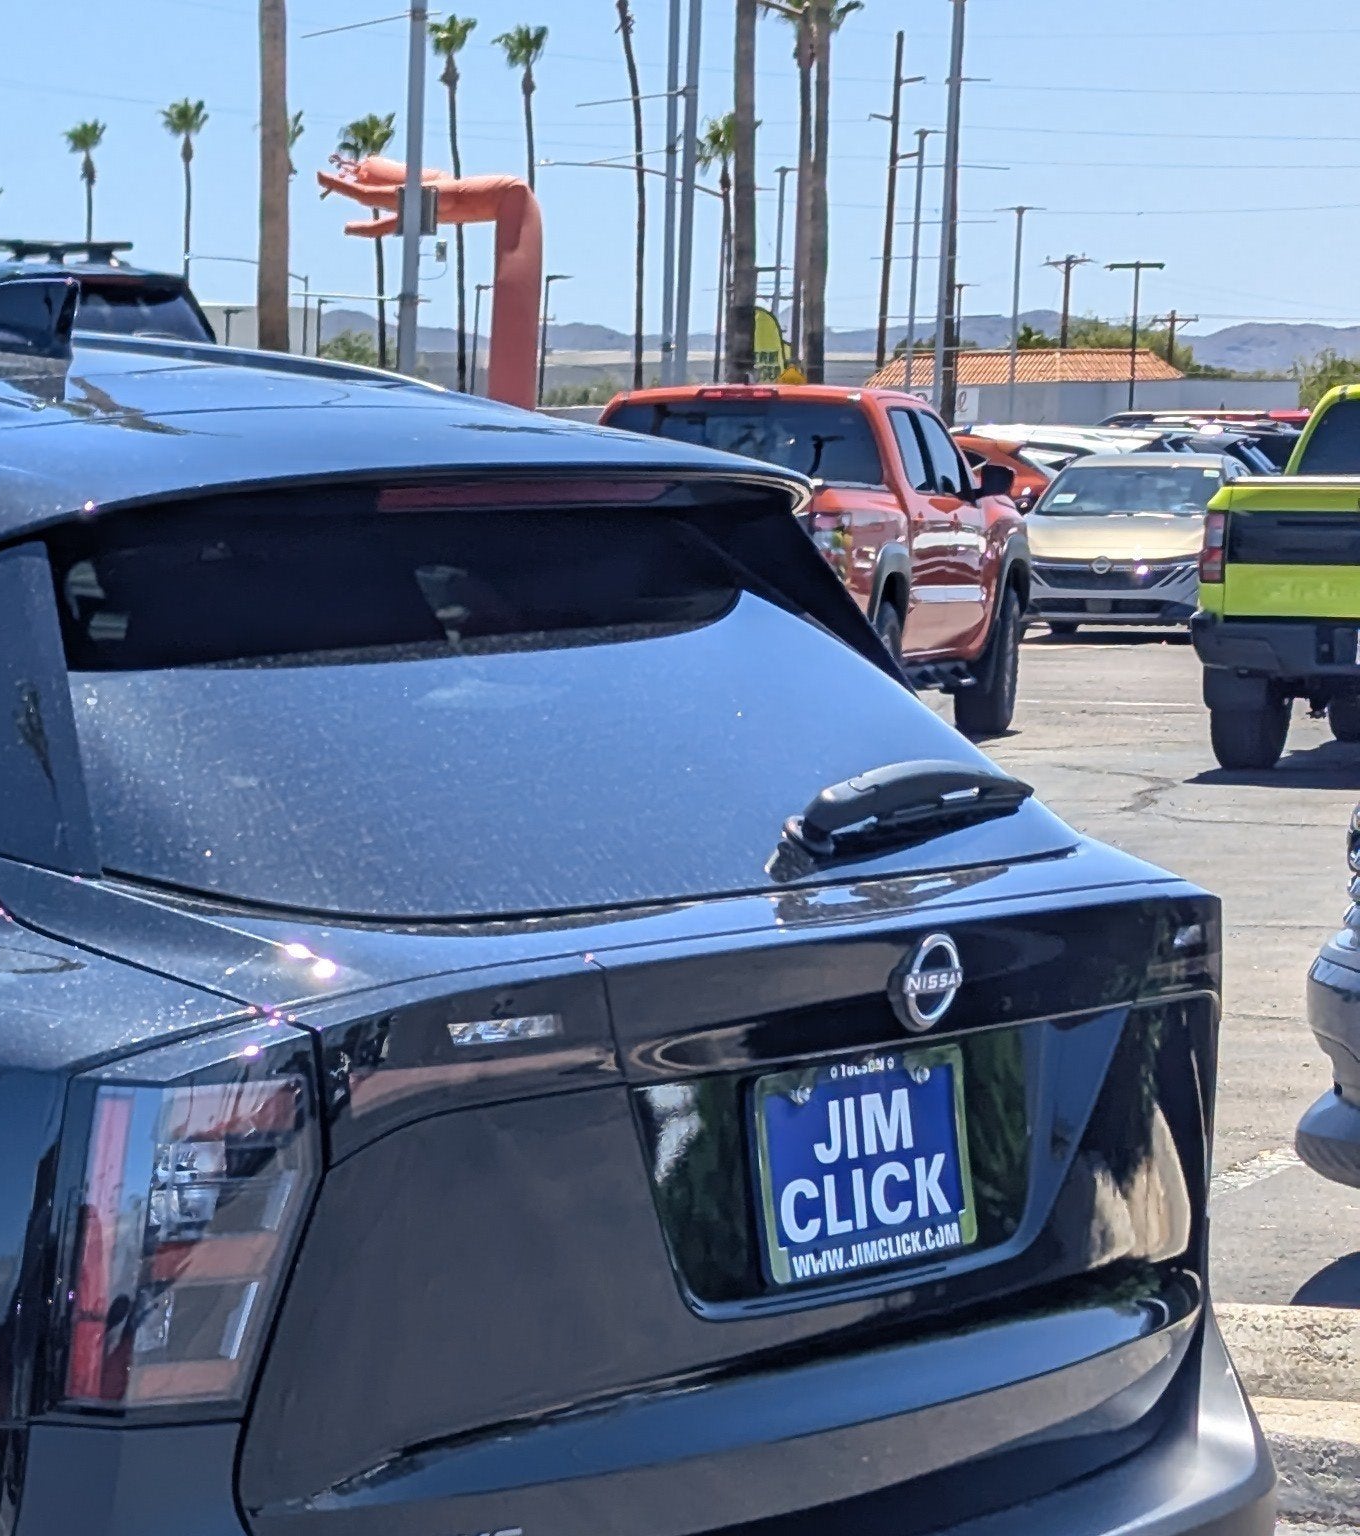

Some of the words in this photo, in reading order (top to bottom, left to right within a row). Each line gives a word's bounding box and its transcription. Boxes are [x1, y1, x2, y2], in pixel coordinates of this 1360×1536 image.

[906, 971, 963, 992] NISSAN
[813, 1087, 914, 1165] JIM
[780, 1152, 952, 1244] CLICK
